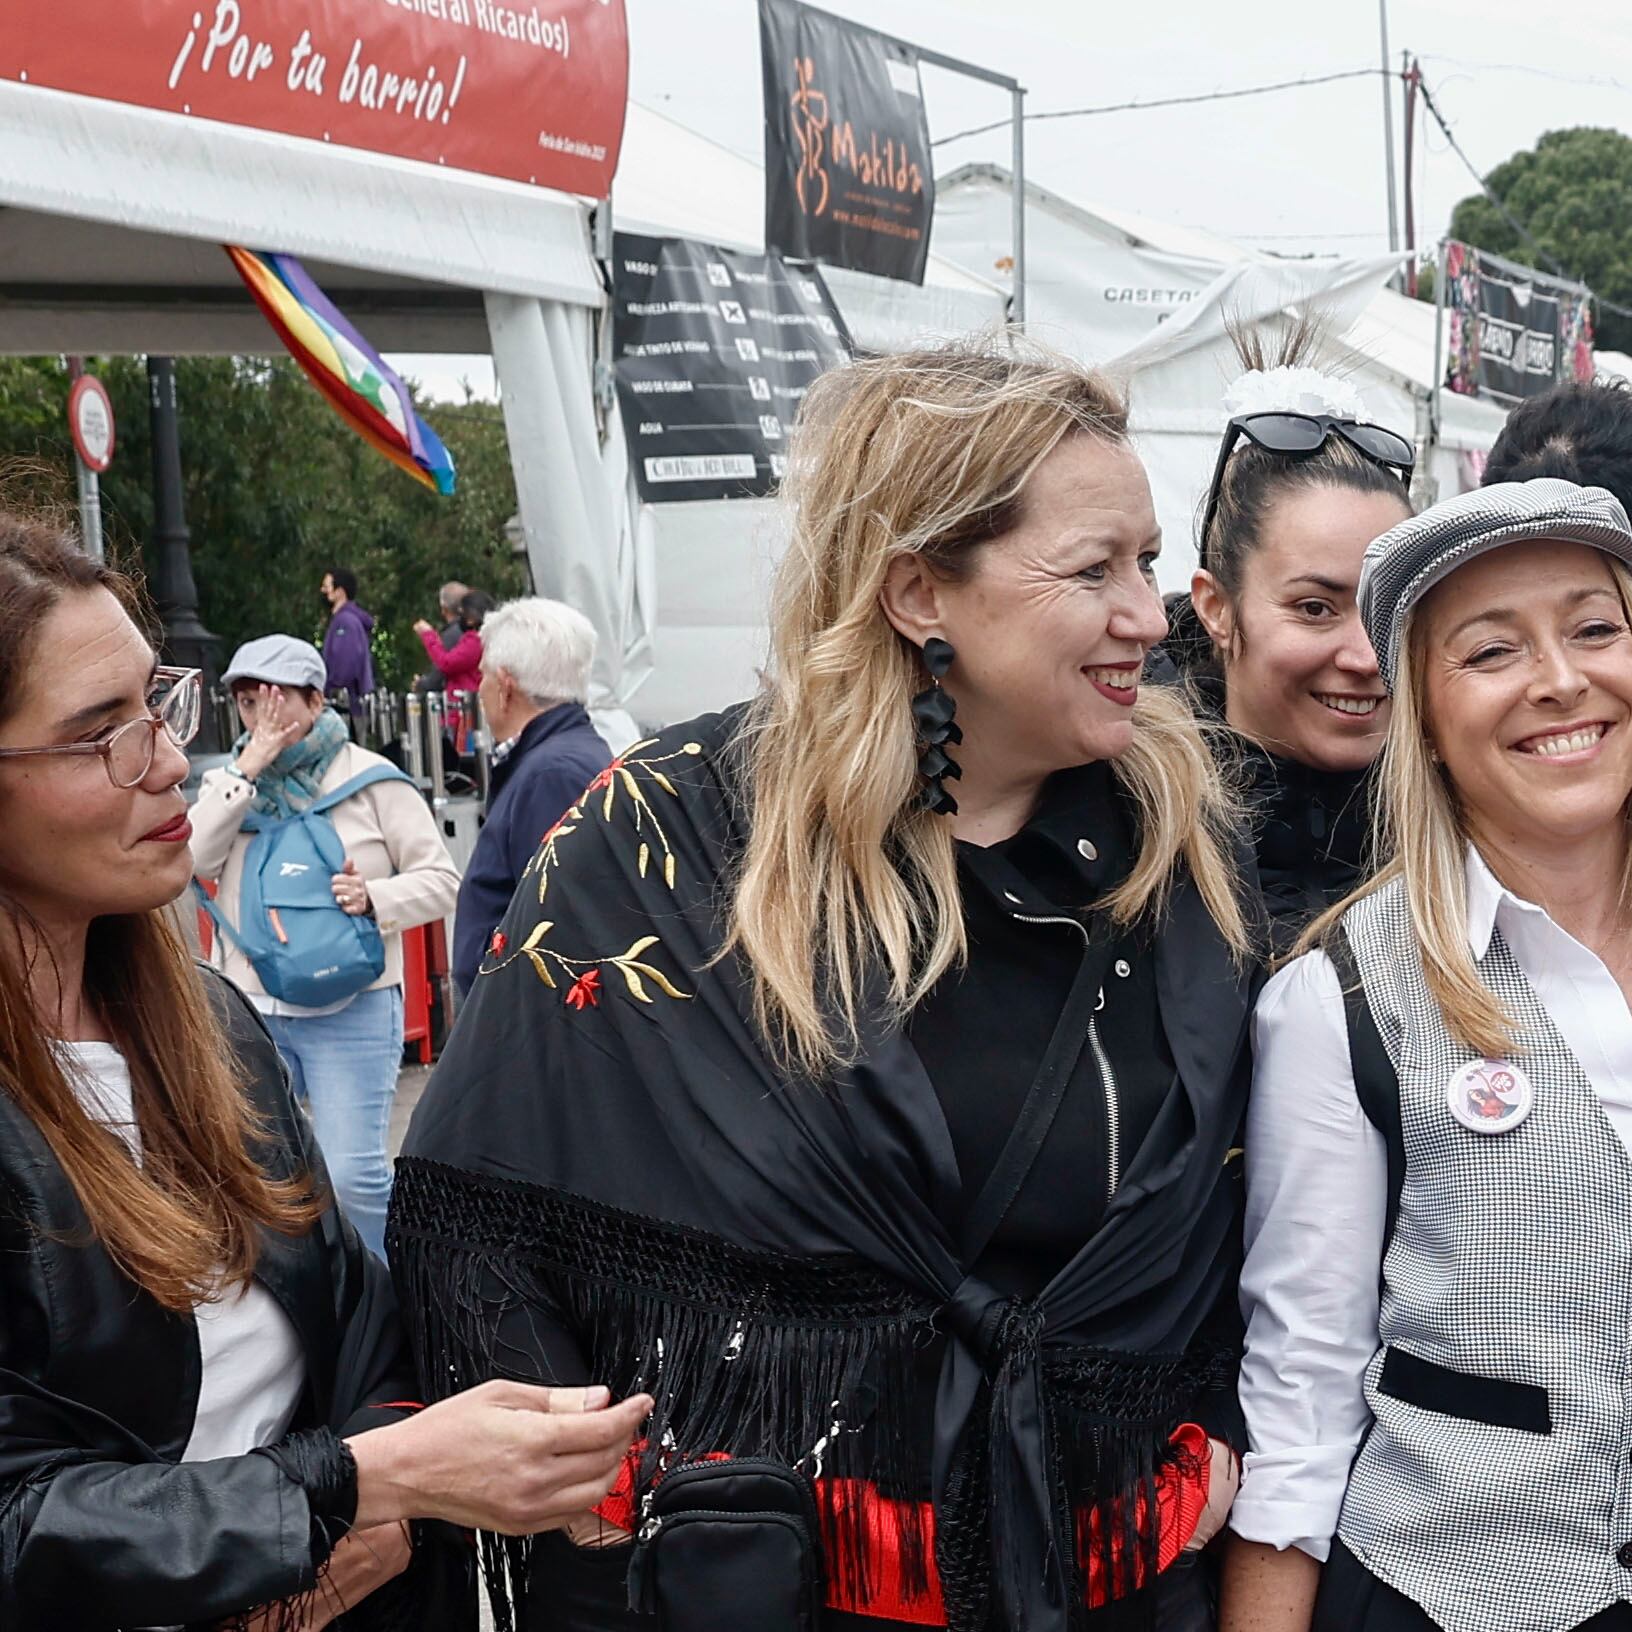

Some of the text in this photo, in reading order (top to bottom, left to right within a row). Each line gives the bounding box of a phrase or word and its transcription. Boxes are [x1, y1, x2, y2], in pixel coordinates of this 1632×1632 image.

[168, 0, 467, 125] ¡Por tu barrio!
[384, 0, 569, 59] eneral Ricardos)
[831, 121, 923, 195] Matilda
